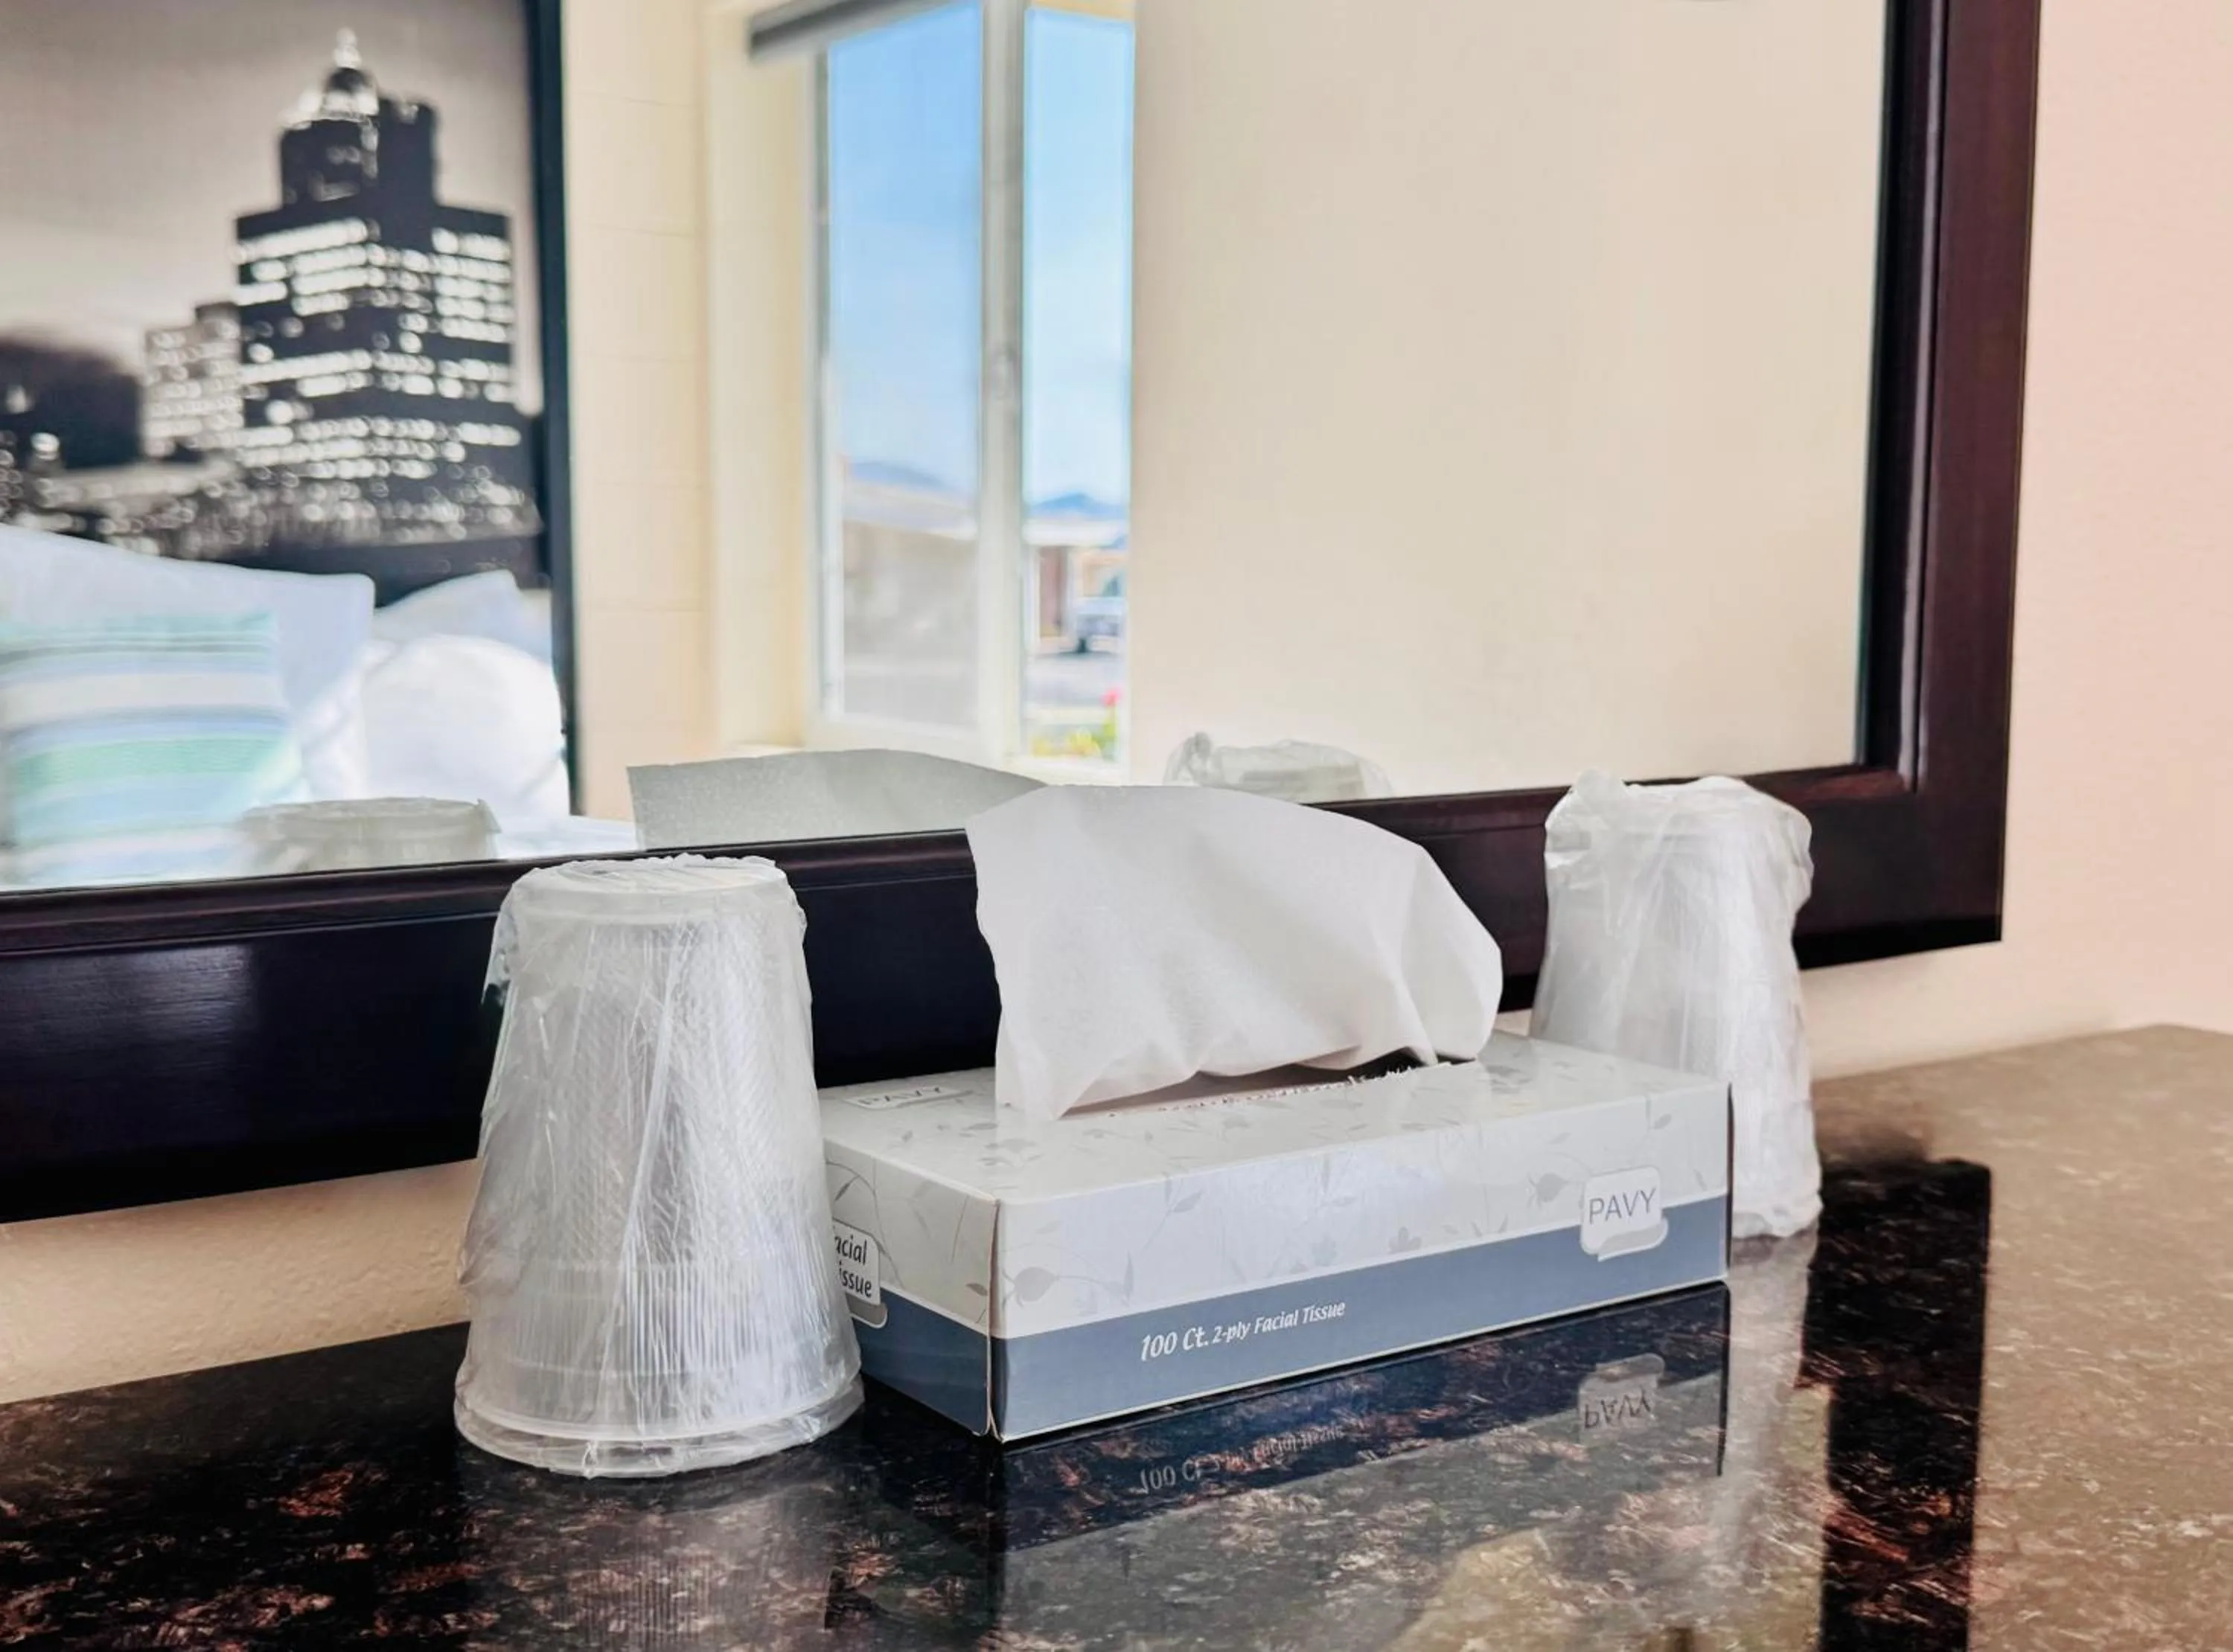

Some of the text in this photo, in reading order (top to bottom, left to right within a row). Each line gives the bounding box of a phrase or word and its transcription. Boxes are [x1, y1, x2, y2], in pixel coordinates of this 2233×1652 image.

[1589, 1188, 1656, 1225] PAVY
[834, 1235, 868, 1265] acial
[838, 1261, 872, 1298] issue
[1140, 1302, 1346, 1362] 100 Ct. 2-ply Facial Tissue
